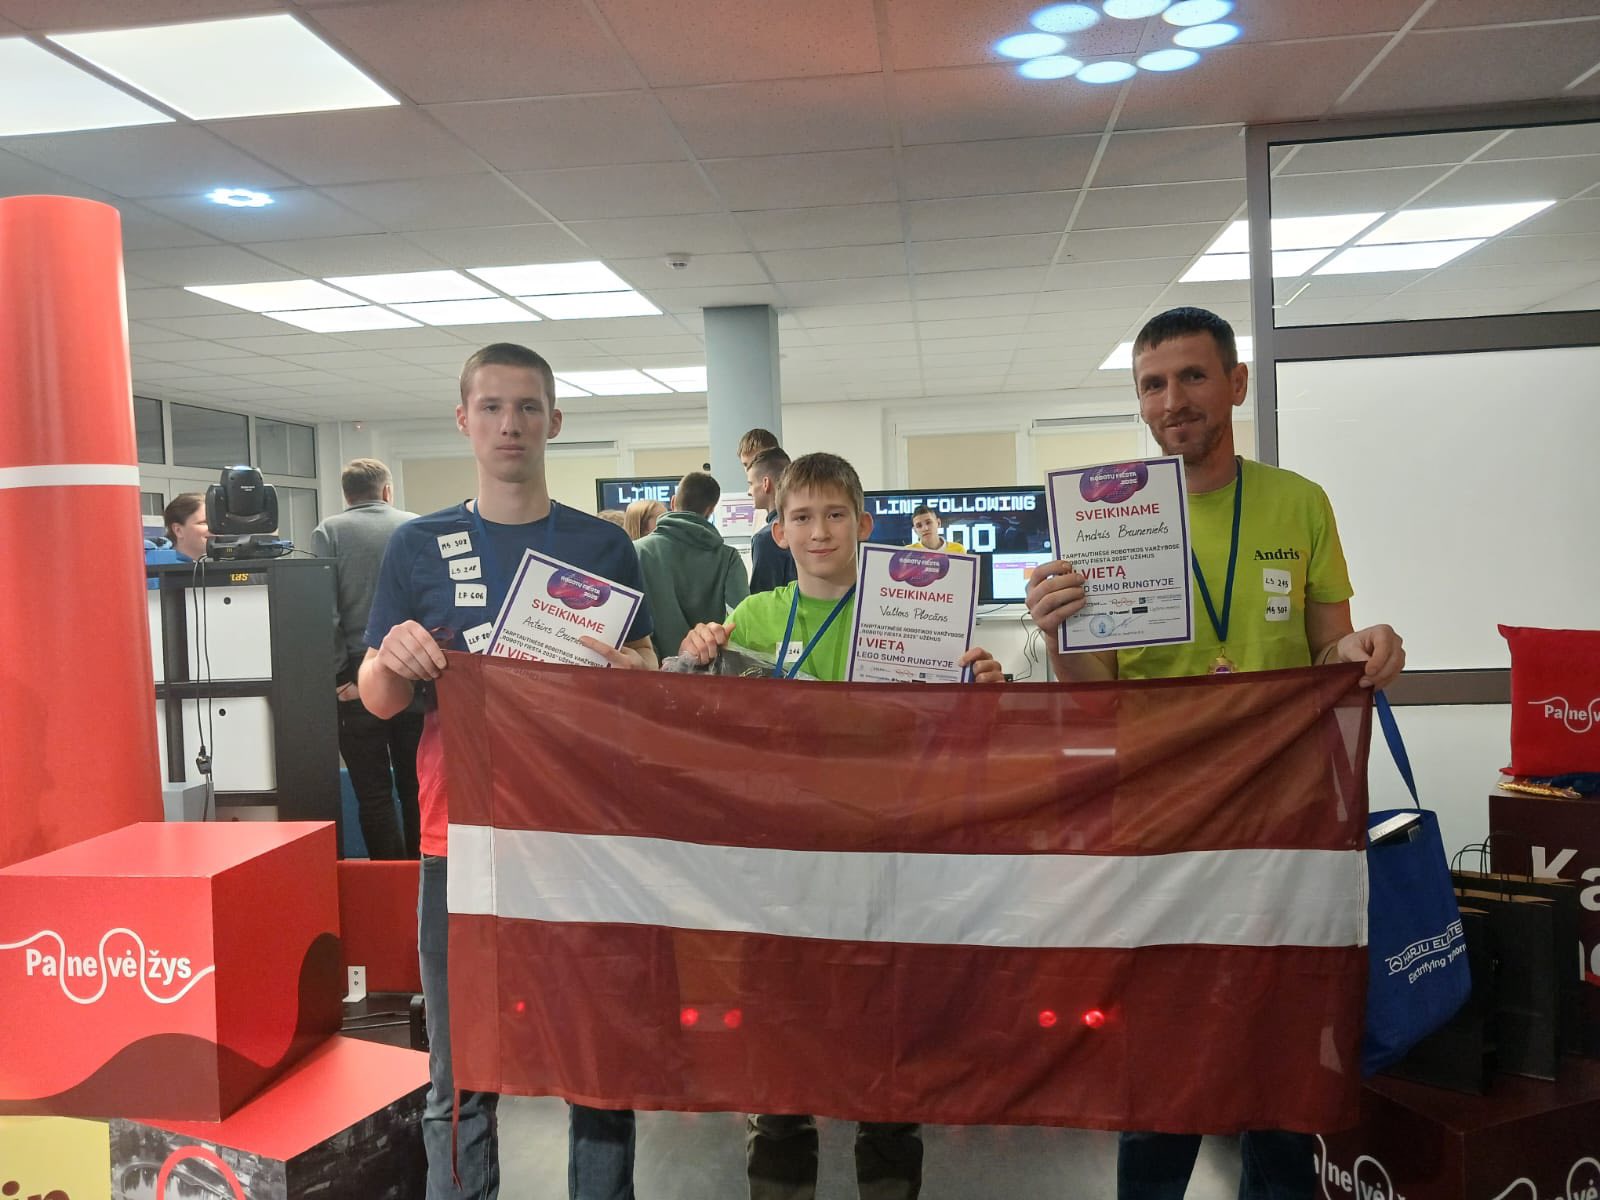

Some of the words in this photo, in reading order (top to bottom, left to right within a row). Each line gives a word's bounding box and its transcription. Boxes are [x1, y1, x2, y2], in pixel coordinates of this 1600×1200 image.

[927, 495, 1036, 513] FOLLOWING
[1075, 503, 1160, 521] SVEIKINAME
[1253, 547, 1300, 561] Andris
[1082, 565, 1126, 580] VIETĄ
[1092, 584, 1120, 593] SUMO
[1122, 578, 1174, 590] RUNGTYJE
[880, 587, 954, 604] SVEIKINAME
[531, 598, 606, 634] SVEIKINAME
[867, 638, 905, 654] VIETĄ
[857, 651, 879, 660] LEGO
[881, 653, 905, 663] SUMO
[907, 656, 954, 668] RUNGTYJE
[25, 948, 192, 986] Panevėžys
